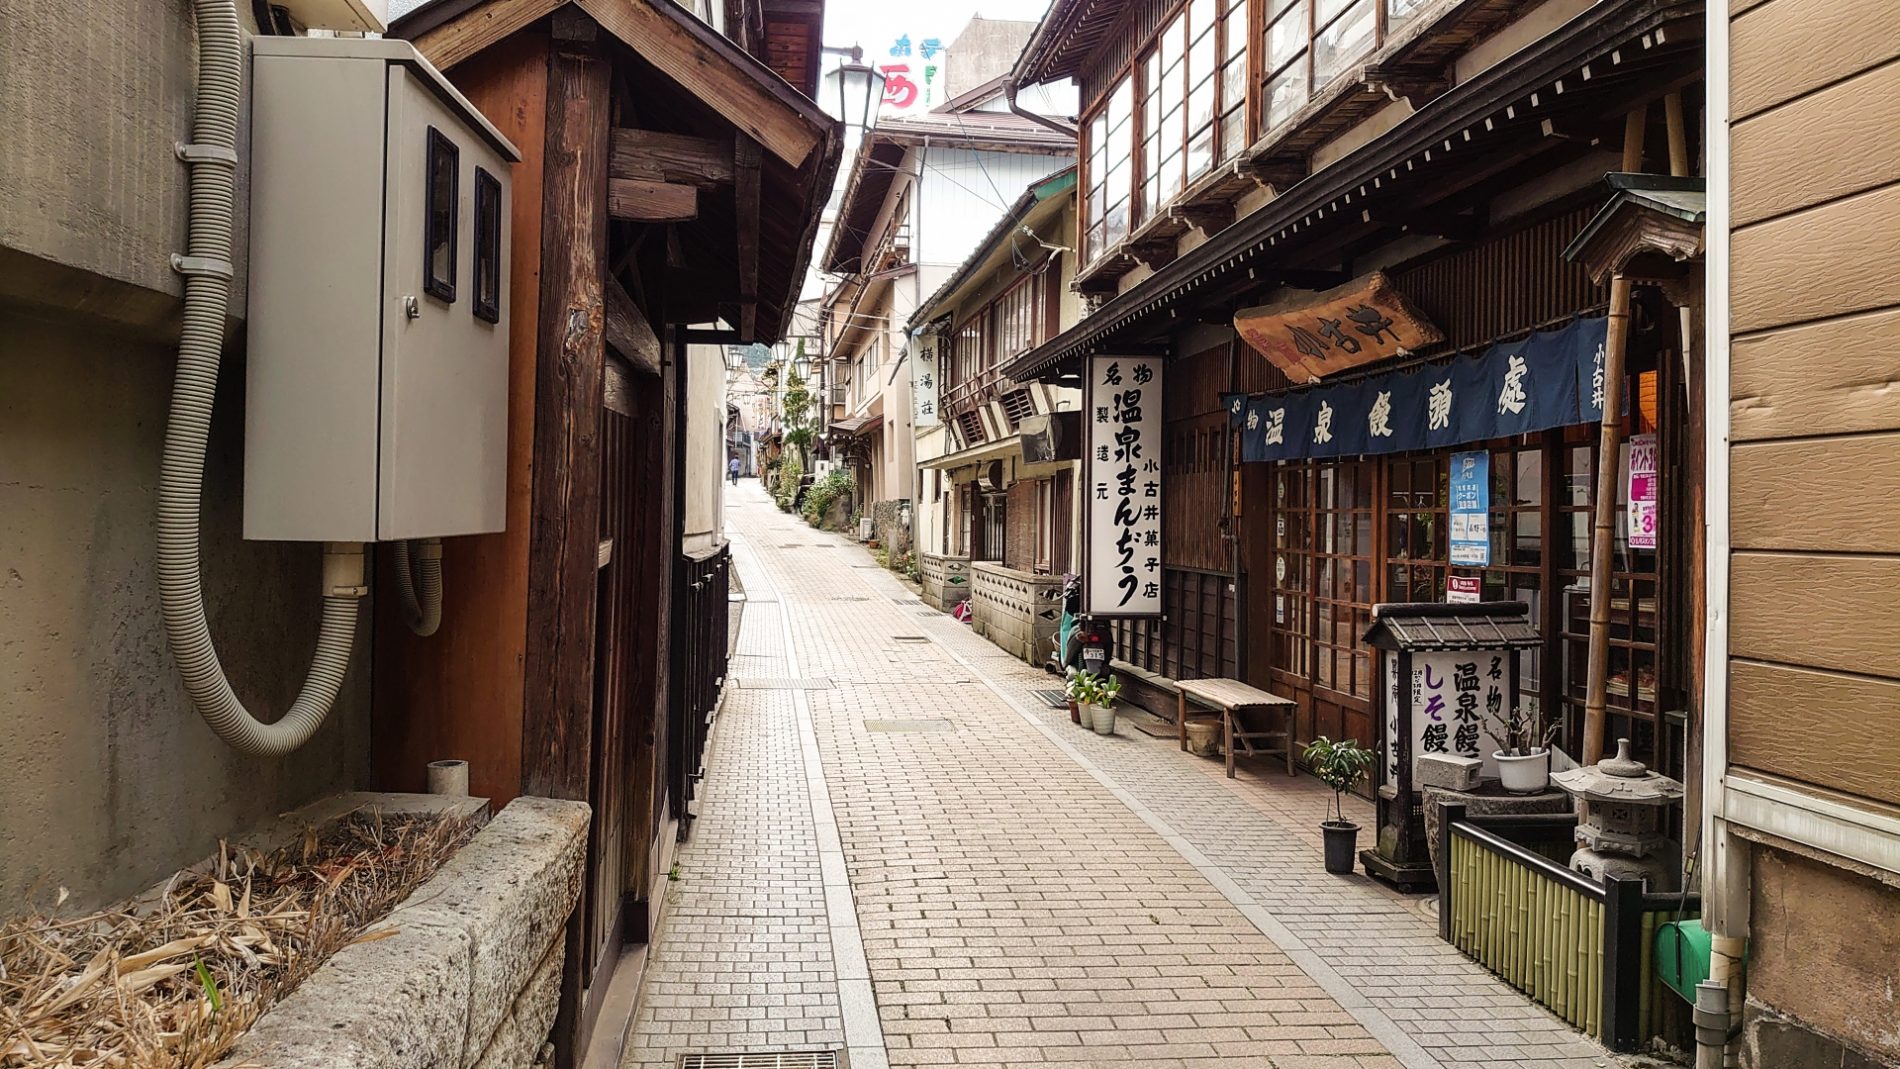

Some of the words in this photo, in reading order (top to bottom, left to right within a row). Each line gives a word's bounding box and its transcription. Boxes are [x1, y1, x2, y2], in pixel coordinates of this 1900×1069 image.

[1101, 361, 1154, 387] 名物
[1095, 405, 1110, 500] 製造元
[1142, 457, 1161, 600] 小古井菓子店
[1453, 661, 1482, 758] 温泉饅
[1486, 655, 1504, 716] 名物
